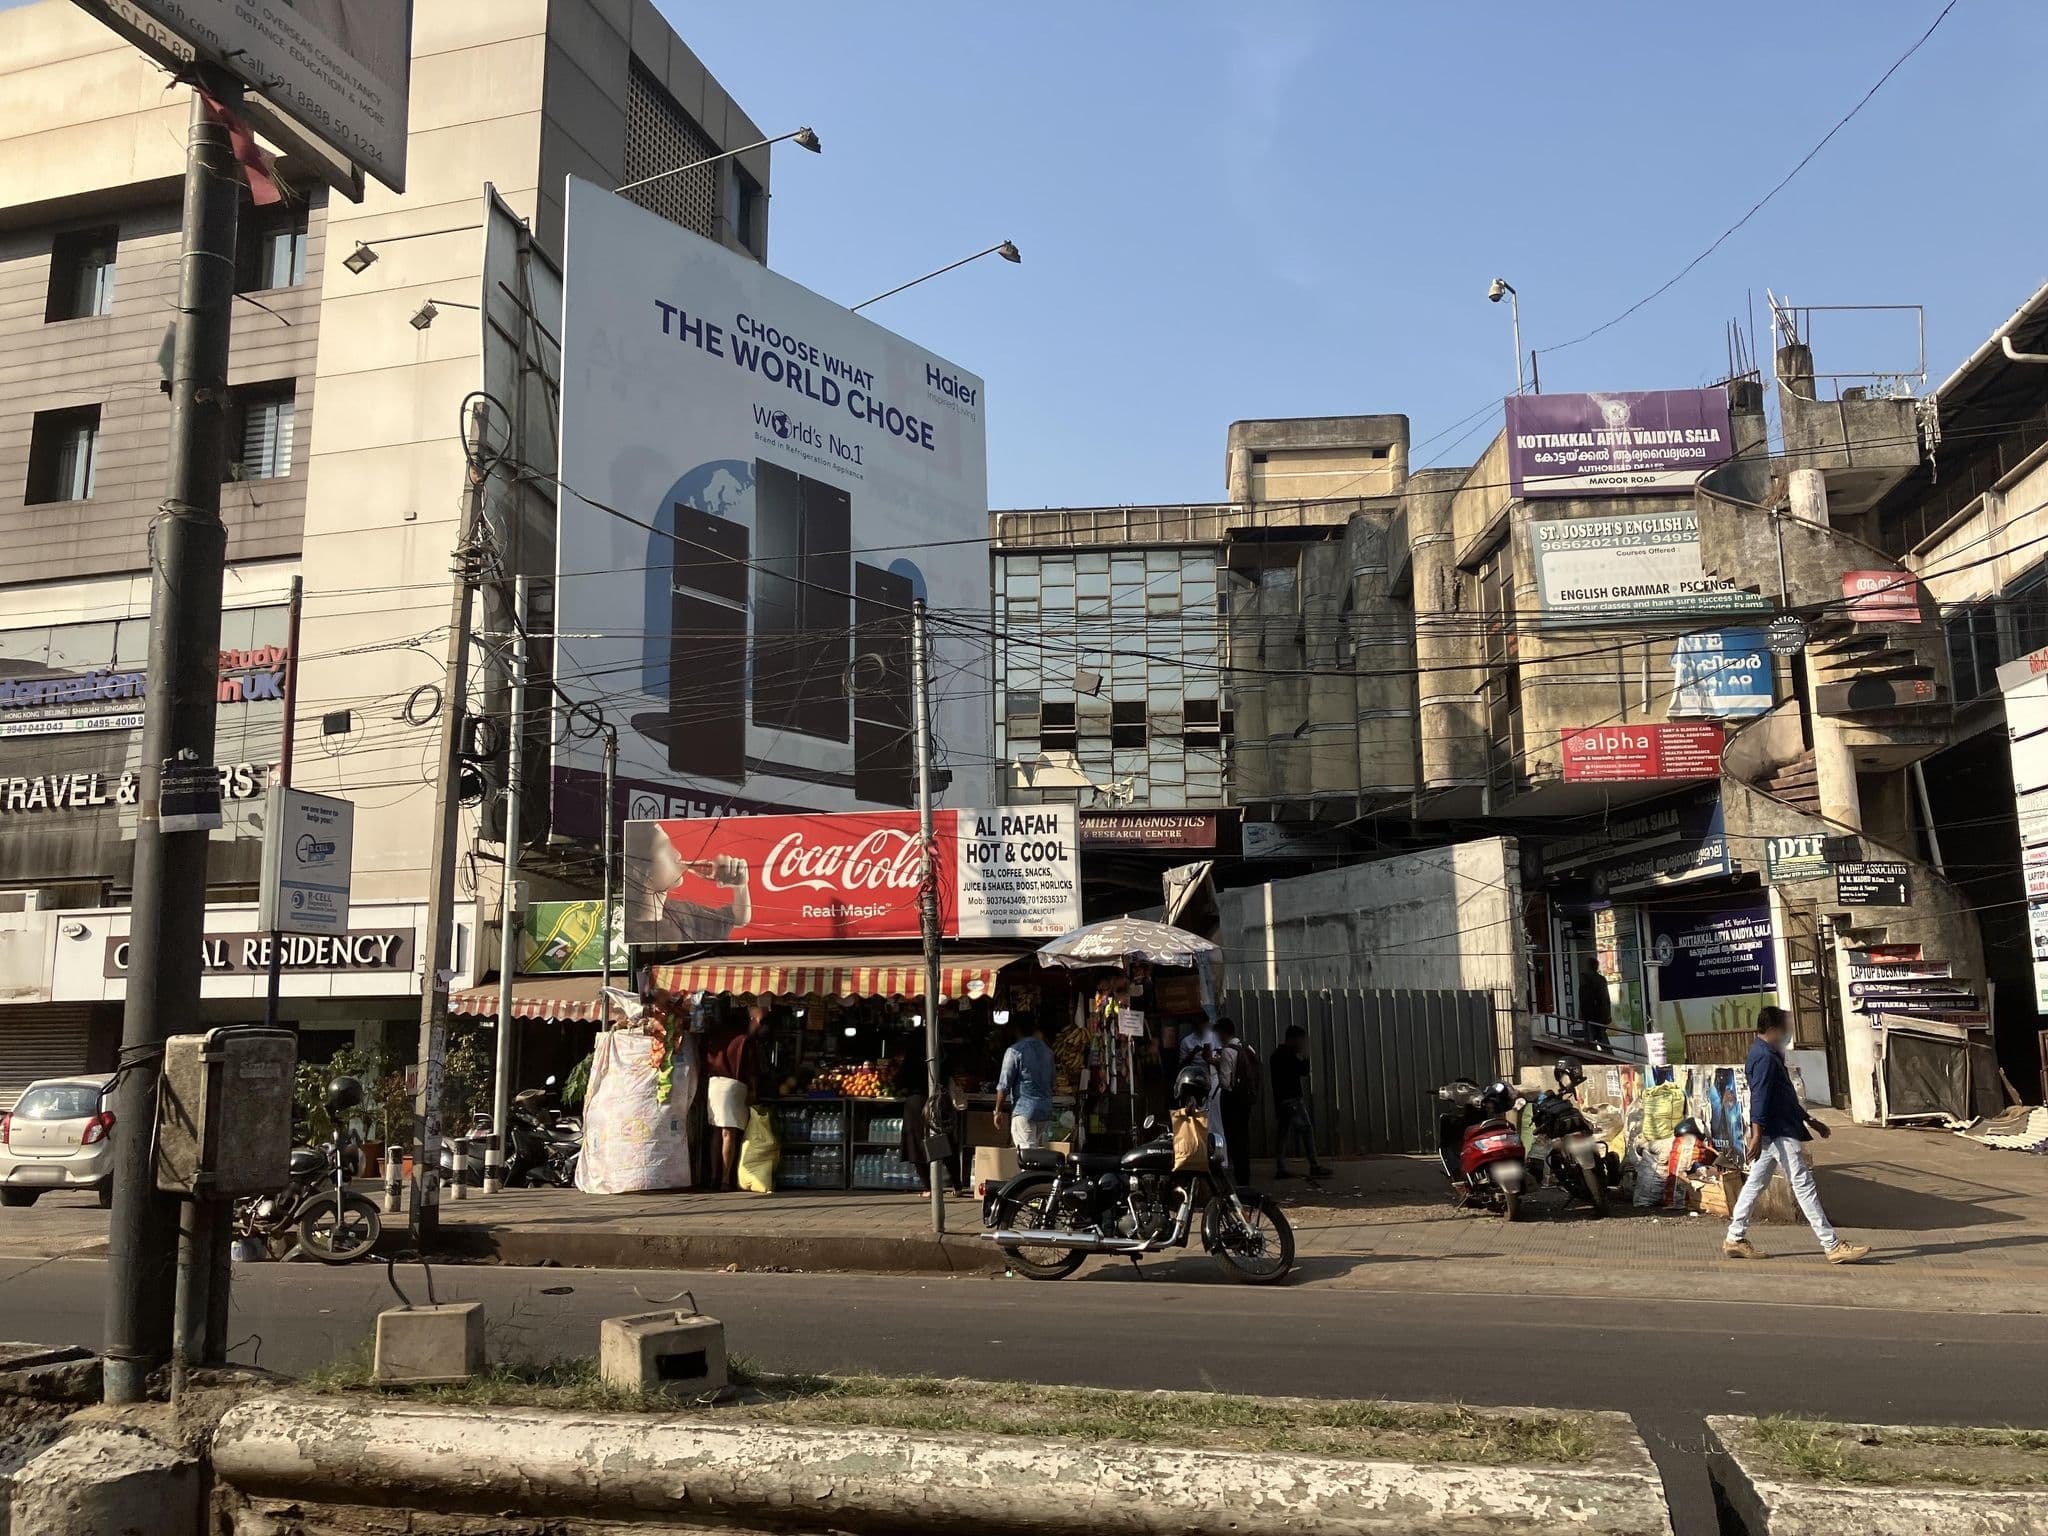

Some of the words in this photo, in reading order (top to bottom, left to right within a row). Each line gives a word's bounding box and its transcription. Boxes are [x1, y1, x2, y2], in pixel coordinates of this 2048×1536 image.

[235, 4, 286, 51] DISTANCE
[288, 46, 346, 97] EDUCATION
[359, 99, 386, 128] MORE
[262, 7, 314, 54] OVERSEAS
[314, 49, 383, 107] CONSULTANCY
[297, 90, 331, 126] 8888
[333, 118, 350, 138] 50
[353, 132, 385, 164] 1234
[736, 313, 820, 367] CHOOSE
[823, 352, 874, 391] WHAT
[655, 300, 724, 359] THE
[731, 333, 841, 407] WORLD
[847, 389, 935, 451] CHOSE
[926, 363, 976, 407] Haier
[1516, 433, 1594, 449] KOTTAKKAL
[1634, 430, 1683, 445] VAIDYA
[1685, 428, 1721, 443] SALA
[754, 431, 776, 446] Brand
[785, 443, 832, 468] Refrigeration
[1578, 464, 1632, 473] AUTHORISED
[1589, 476, 1629, 485] MAVOOR
[1631, 476, 1656, 484] ROAD
[1539, 526, 1560, 541] ST.
[1562, 521, 1623, 540] JOSEPH'S
[1625, 517, 1683, 536] ENGLISH
[1561, 586, 1609, 601] ENGLISH
[1612, 583, 1670, 598] GRAMMAR
[1600, 601, 1631, 611] classes
[1634, 600, 1650, 609] and
[1652, 599, 1674, 608] have
[1676, 597, 1696, 605] sure
[1698, 594, 1733, 605] success
[1735, 593, 1743, 601] in
[1745, 593, 1761, 602] any
[243, 672, 284, 700] UK
[4, 712, 23, 720] HONG
[23, 711, 40, 719] KONG
[44, 708, 67, 717] BEIJING
[72, 706, 100, 715] SHARJAH
[104, 703, 140, 713] SINGAPORE
[1585, 732, 1649, 753] alpha
[116, 770, 137, 805] &
[975, 816, 997, 837] AL
[1001, 814, 1058, 836] RAFAH
[1121, 816, 1206, 828] DIAGNOSTICS
[1092, 830, 1141, 838] RESEARCH
[1145, 829, 1182, 838] CENTRE
[762, 829, 923, 892] Coca-Cola
[966, 843, 1001, 864] HOT
[1005, 842, 1016, 863] &
[1020, 841, 1068, 862] COOL
[982, 869, 996, 879] TEA,
[997, 868, 1024, 879] COFFEE,
[1025, 867, 1053, 878] SNACKS,
[1838, 865, 1864, 874] MADHU
[1865, 864, 1907, 875] ASSOCIATES
[963, 882, 981, 891] JUICE
[982, 882, 987, 891] &
[988, 881, 1015, 892] SHAKES,
[1016, 881, 1039, 891] BOOST,
[1040, 880, 1073, 890] HORLICKS
[803, 905, 836, 918] Real
[968, 897, 985, 905] Mob:
[1678, 932, 1714, 947] KOTTAKKAL
[1714, 929, 1730, 944] ARYA
[1730, 927, 1754, 942] VAIDYA
[1754, 923, 1772, 937] SALA
[241, 934, 397, 967] RESIDENCY
[1699, 956, 1732, 966] AUTHORISED
[1732, 953, 1754, 962] DEALER
[1851, 966, 1875, 980] LAPTOP
[1881, 965, 1911, 979] DESKTOP
